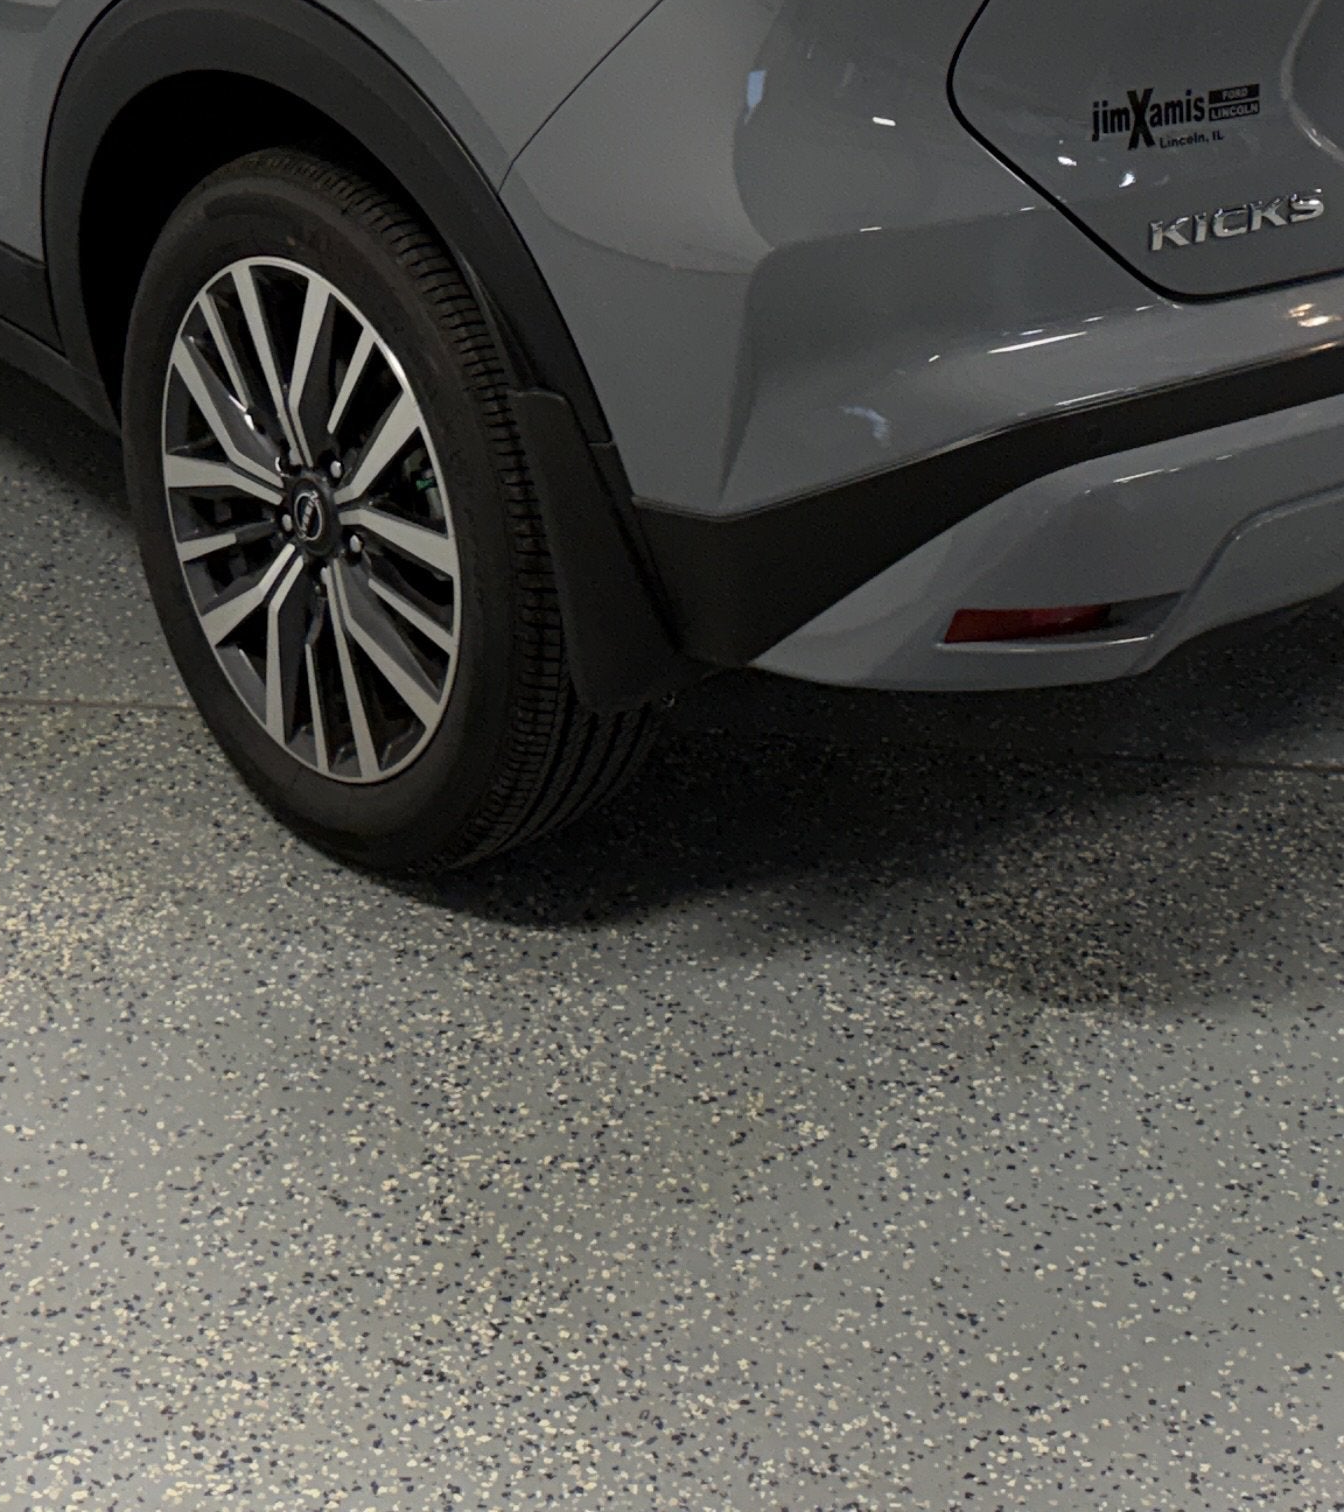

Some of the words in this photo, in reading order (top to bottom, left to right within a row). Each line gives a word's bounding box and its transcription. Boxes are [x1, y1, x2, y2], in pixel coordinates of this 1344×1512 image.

[1091, 88, 1206, 150] jimXamis
[1210, 103, 1259, 119] LINCOLN
[1148, 192, 1325, 252] KICKS
